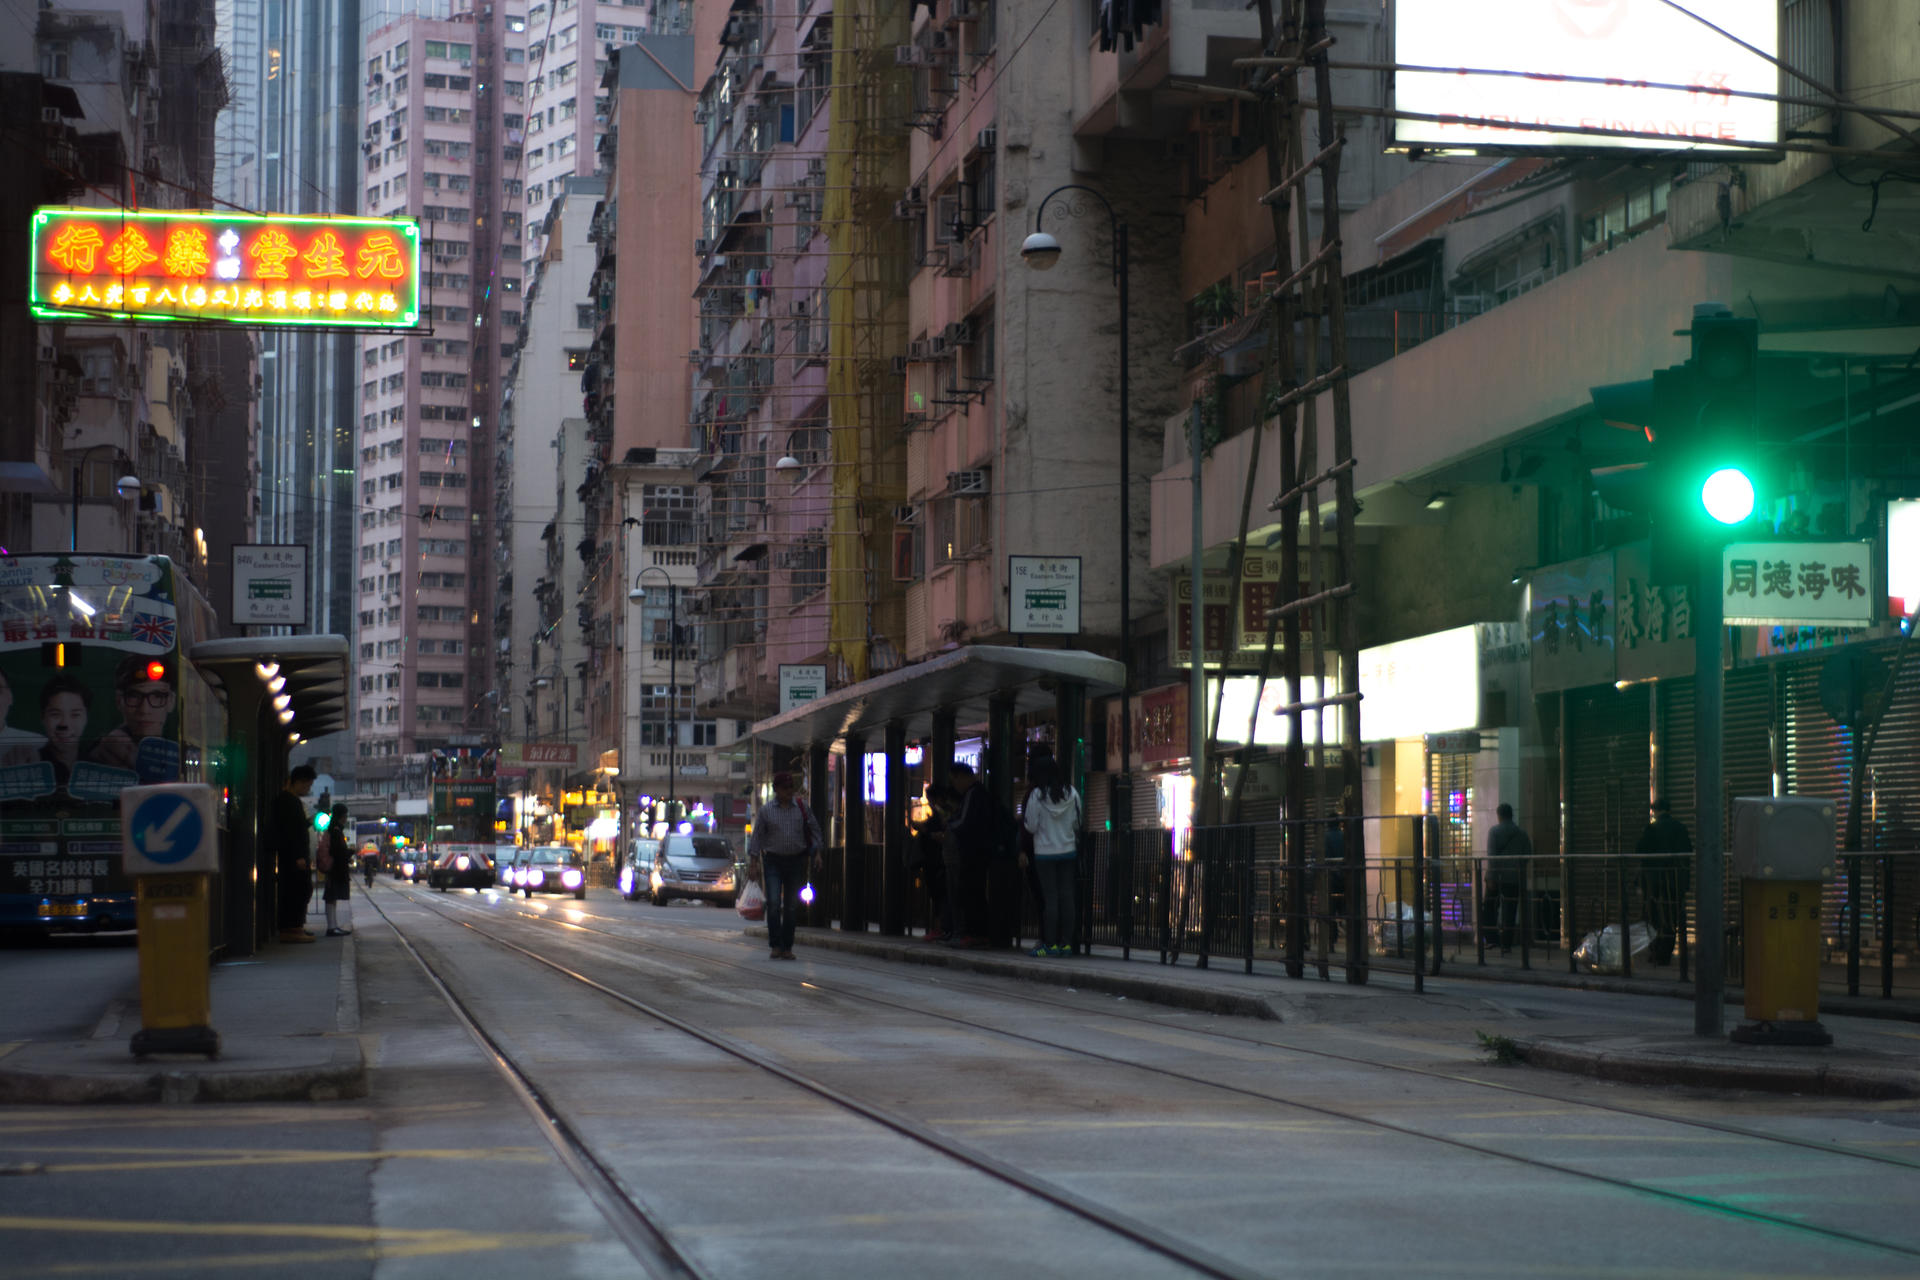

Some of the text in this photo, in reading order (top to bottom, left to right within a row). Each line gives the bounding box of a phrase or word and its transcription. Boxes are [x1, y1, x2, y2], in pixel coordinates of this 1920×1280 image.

[1727, 559, 1866, 600] 同德海味
[13, 860, 109, 877] 英國名校校長
